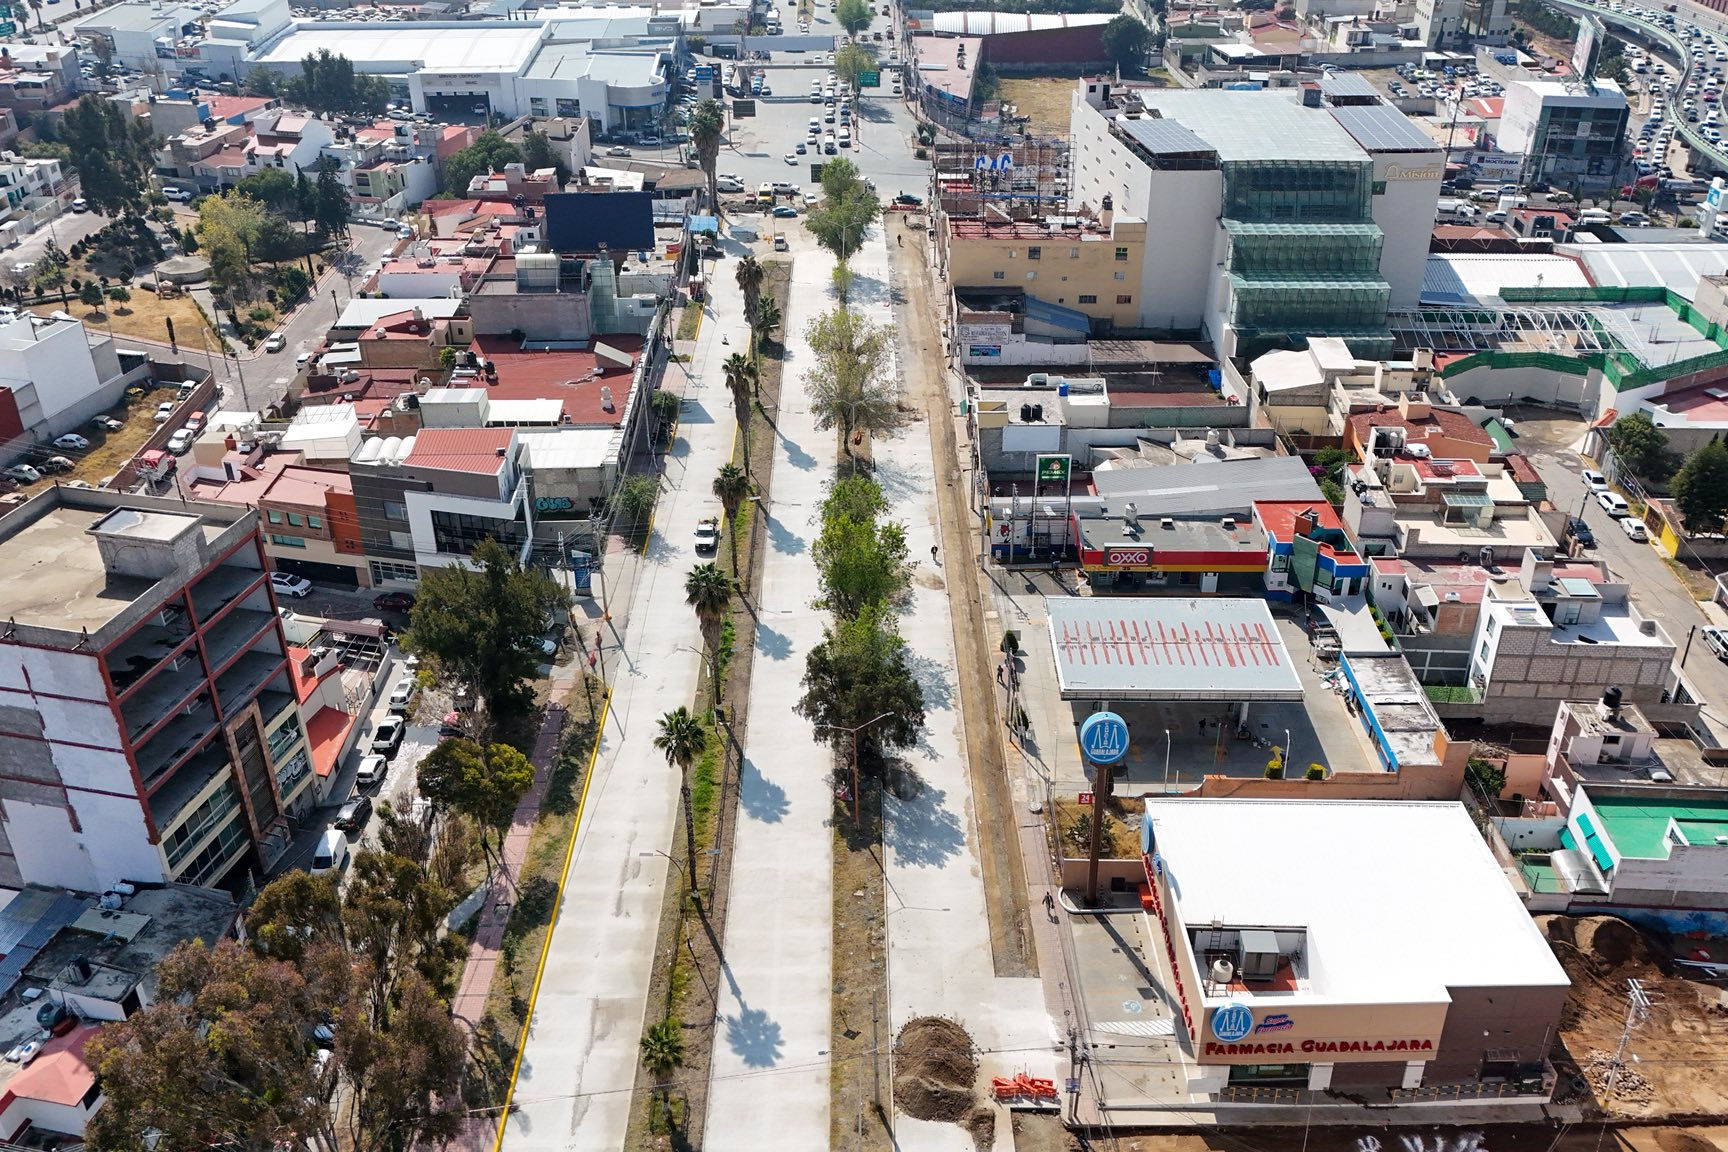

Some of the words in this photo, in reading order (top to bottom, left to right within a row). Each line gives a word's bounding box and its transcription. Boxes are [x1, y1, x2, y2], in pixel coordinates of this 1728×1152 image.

[1110, 552, 1148, 564] OXXO
[1205, 1042, 1295, 1056] FARMACIA
[1300, 1039, 1433, 1053] GUADALAJARA
